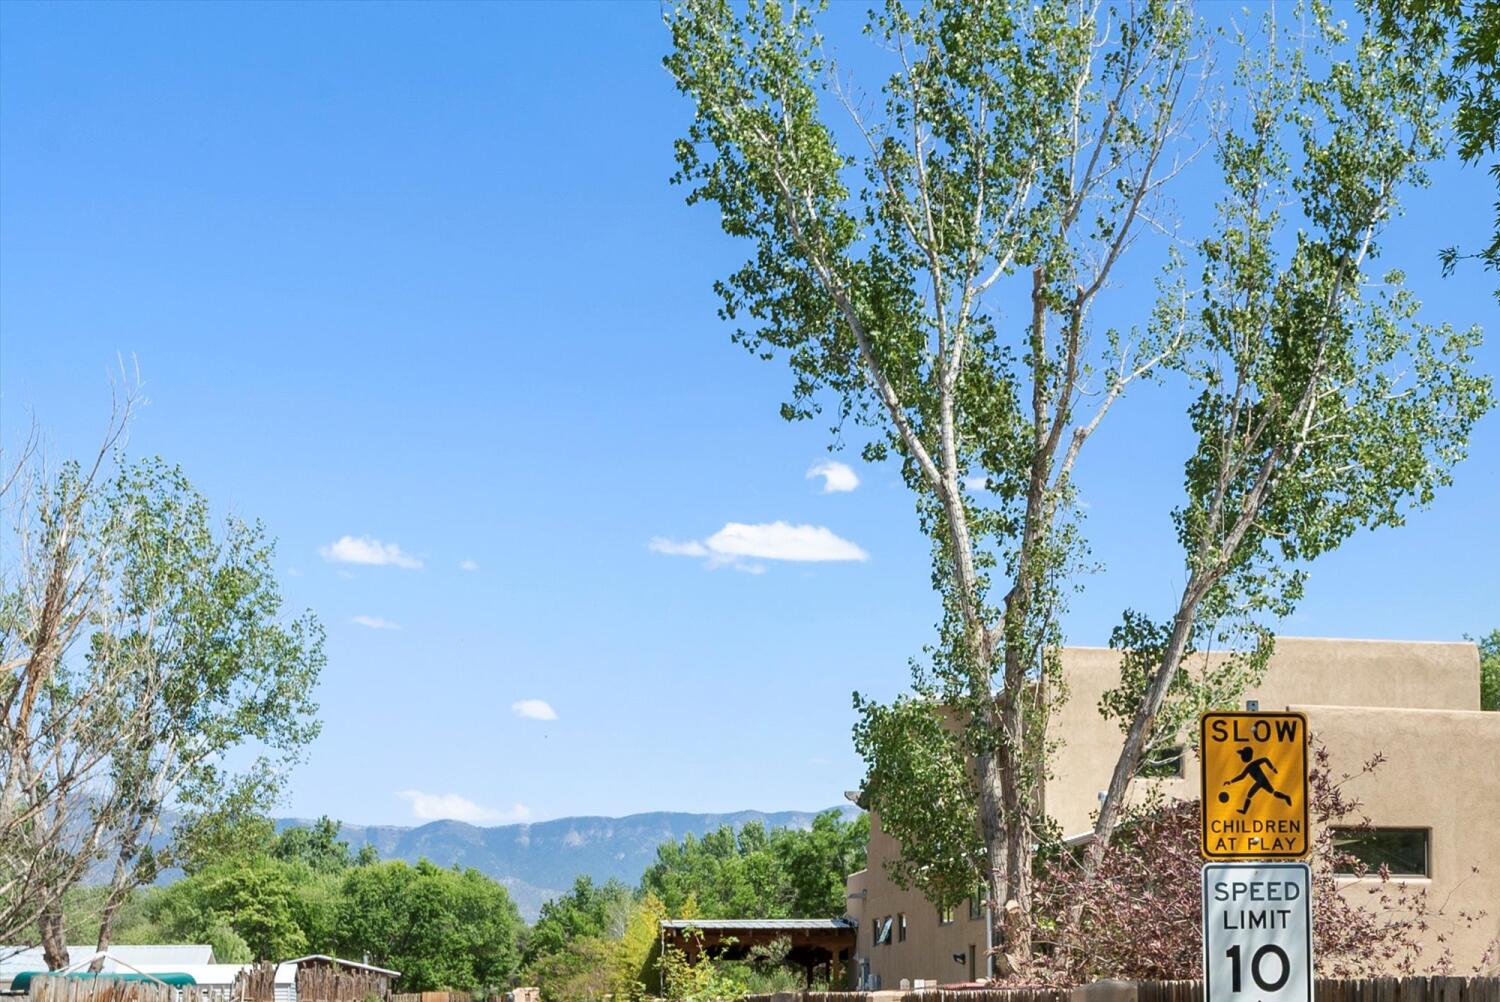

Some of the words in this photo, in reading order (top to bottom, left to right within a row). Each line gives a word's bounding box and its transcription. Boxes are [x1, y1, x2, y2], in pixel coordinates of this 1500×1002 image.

[1211, 719, 1297, 742] SLOW
[1211, 820, 1300, 833] CHILDREN
[1215, 838, 1237, 850] AT
[1248, 838, 1297, 850] PLAY
[1214, 882, 1300, 901] SPEED
[1223, 910, 1291, 929] LIMIT
[1226, 944, 1290, 992] 10
